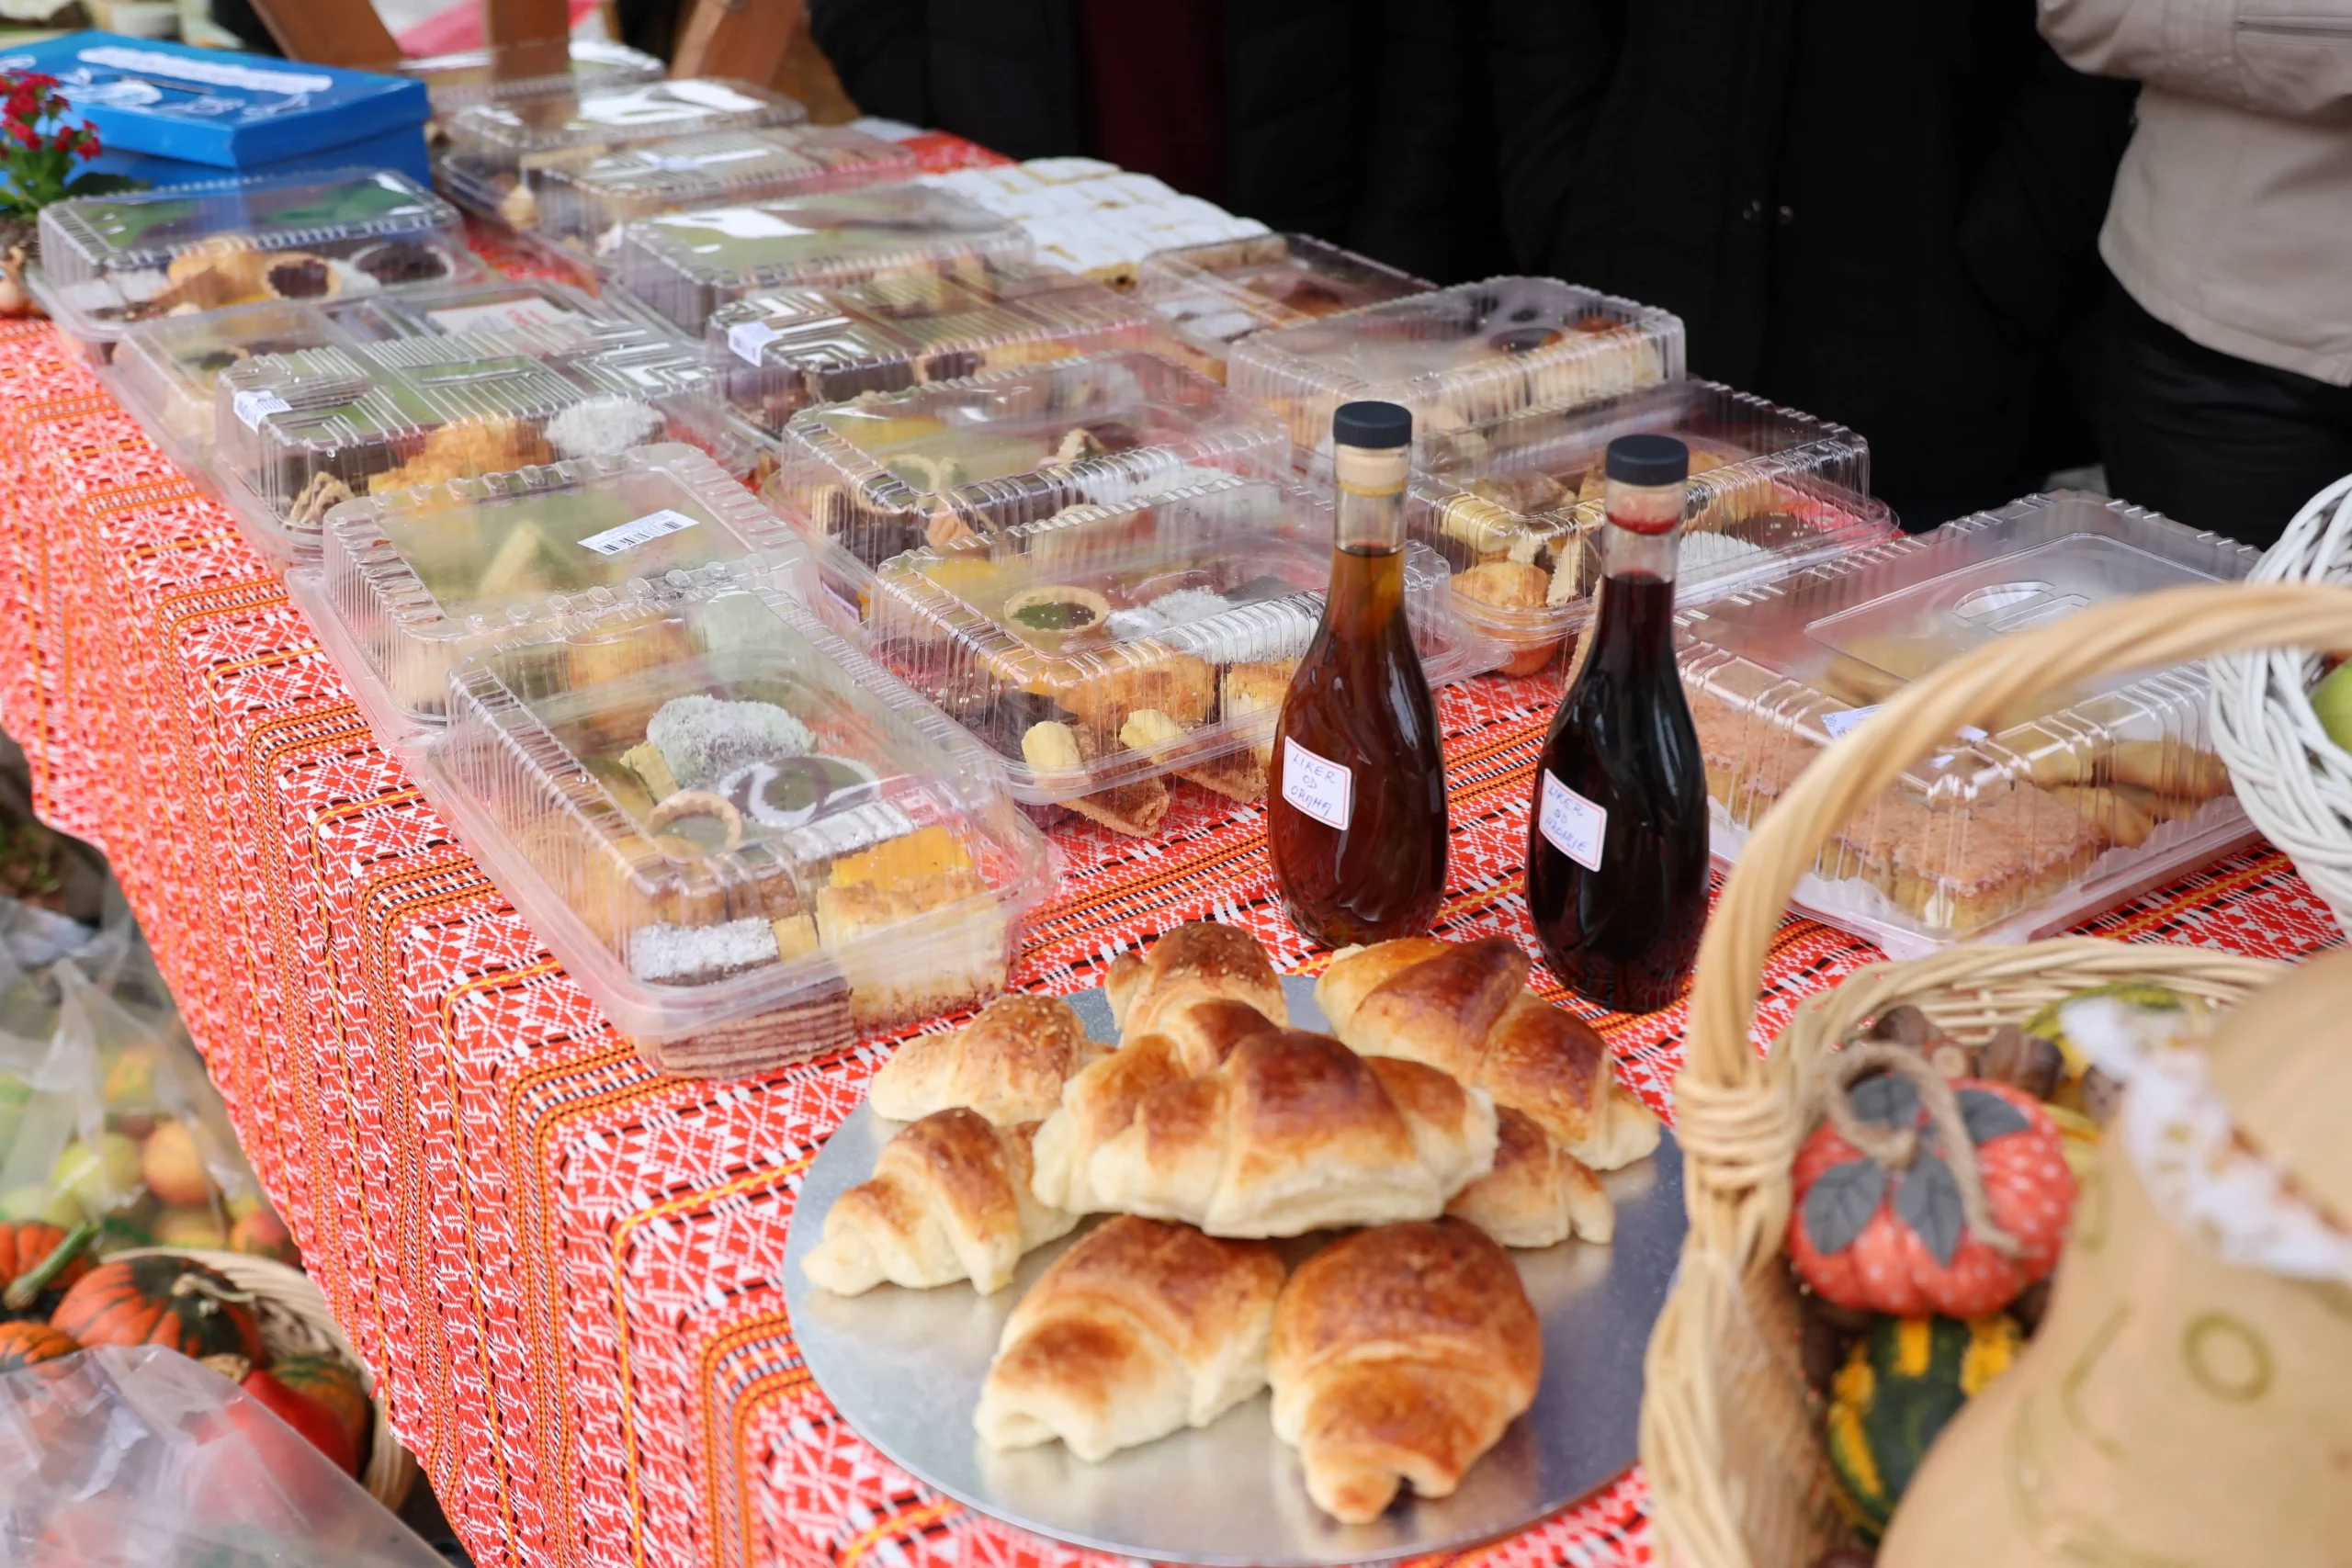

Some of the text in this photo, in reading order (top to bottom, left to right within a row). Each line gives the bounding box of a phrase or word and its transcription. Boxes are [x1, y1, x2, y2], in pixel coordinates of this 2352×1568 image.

[1293, 753, 1335, 784] LIKER
[1302, 774, 1317, 789] OD
[1291, 785, 1332, 817] ORAHA
[1548, 785, 1584, 817] LIKER
